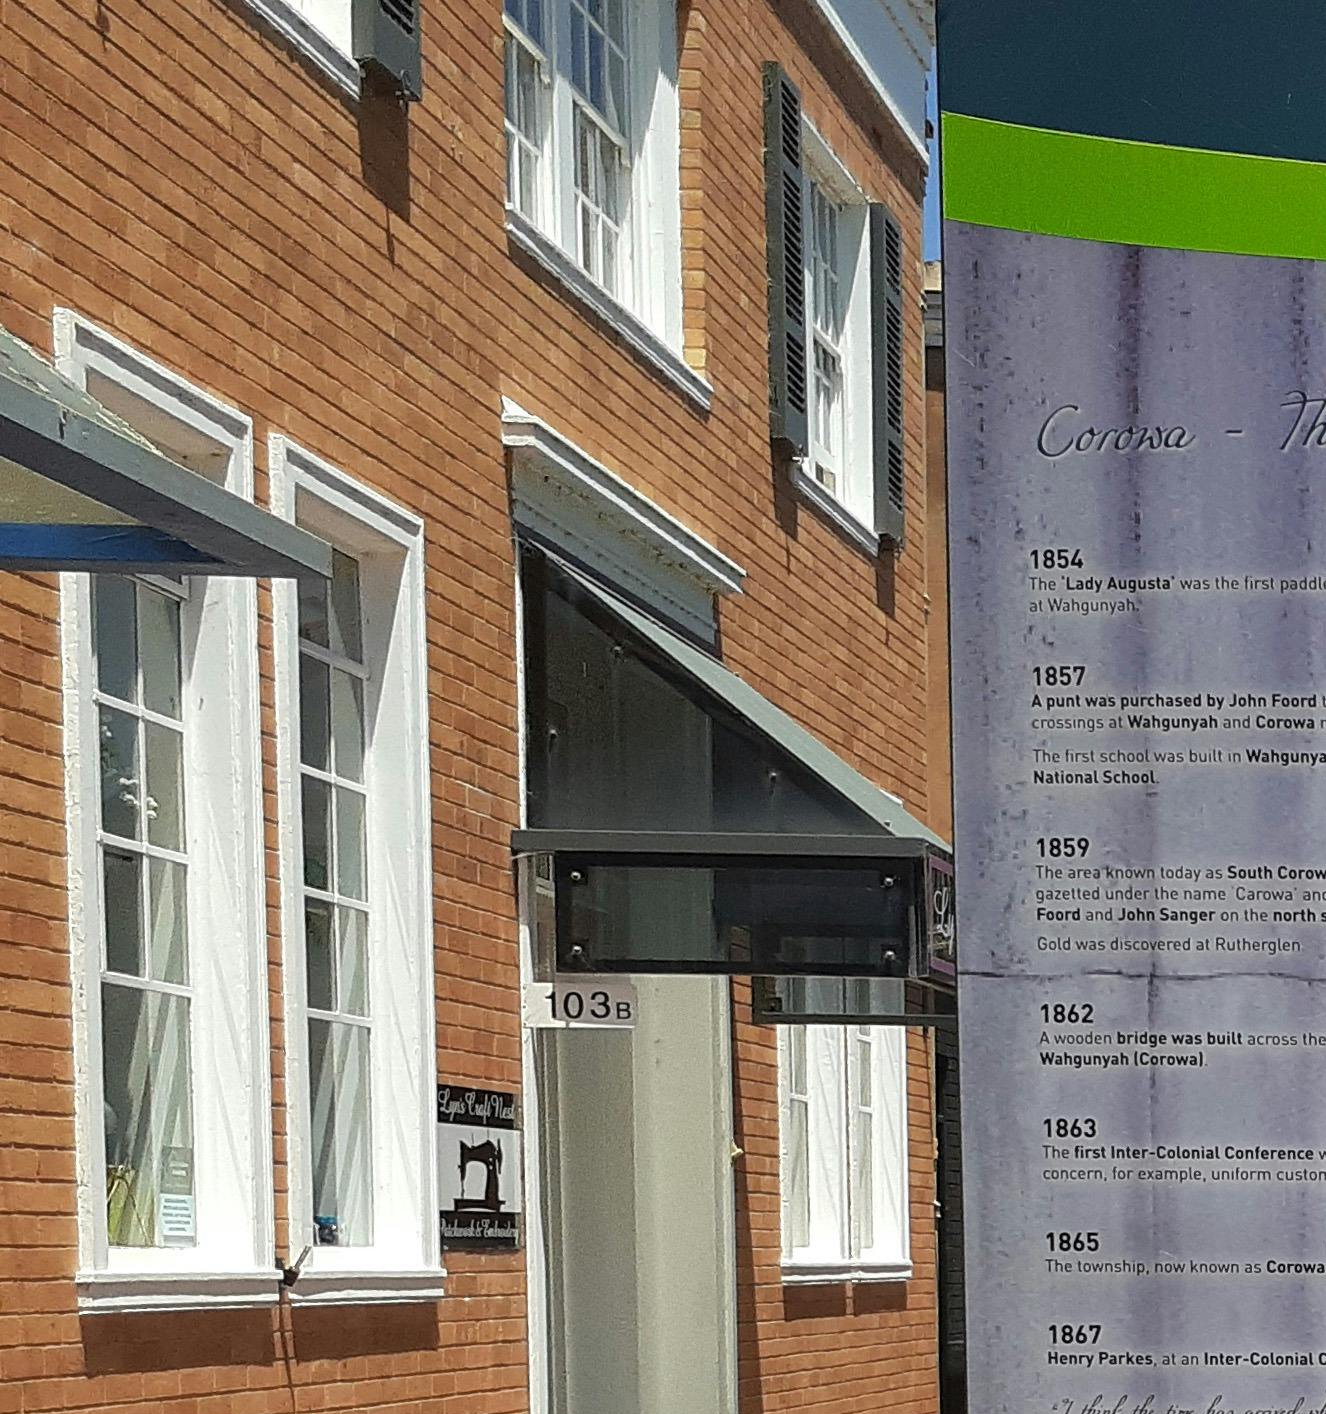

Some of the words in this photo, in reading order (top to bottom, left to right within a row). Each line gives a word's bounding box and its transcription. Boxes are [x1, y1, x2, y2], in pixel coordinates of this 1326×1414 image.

[1036, 403, 1197, 459] Corowa
[1030, 548, 1084, 569] 1854
[1028, 575, 1057, 591] The
[1179, 578, 1211, 590] was
[1214, 575, 1240, 590] the
[1244, 574, 1275, 590] first
[1029, 599, 1044, 613] at
[1047, 597, 1143, 616] Wahgunyah.
[1032, 664, 1086, 686] 1857
[1031, 692, 1043, 708] A
[1046, 693, 1081, 711] punt
[1084, 695, 1116, 707] was
[1120, 692, 1202, 710] purchased
[1206, 692, 1225, 710] by
[1228, 692, 1267, 707] John
[1271, 693, 1317, 708] Foord
[1033, 769, 1100, 785] National
[1102, 769, 1160, 784] School.
[1036, 836, 1090, 857] 1859
[1040, 1003, 1094, 1024] 1862
[1039, 1051, 1130, 1069] Wahgunyah
[1133, 1050, 1204, 1073] (Corowa).
[1043, 1117, 1097, 1138] 1863
[1045, 1231, 1100, 1252] 1865
[1048, 1323, 1102, 1344] 1867
[1047, 1350, 1095, 1368] Henry
[1098, 1350, 1157, 1366] Parkes,
[1161, 1352, 1177, 1366] at
[1181, 1355, 1199, 1366] an
[1204, 1351, 1314, 1366] Inter-Colonial
